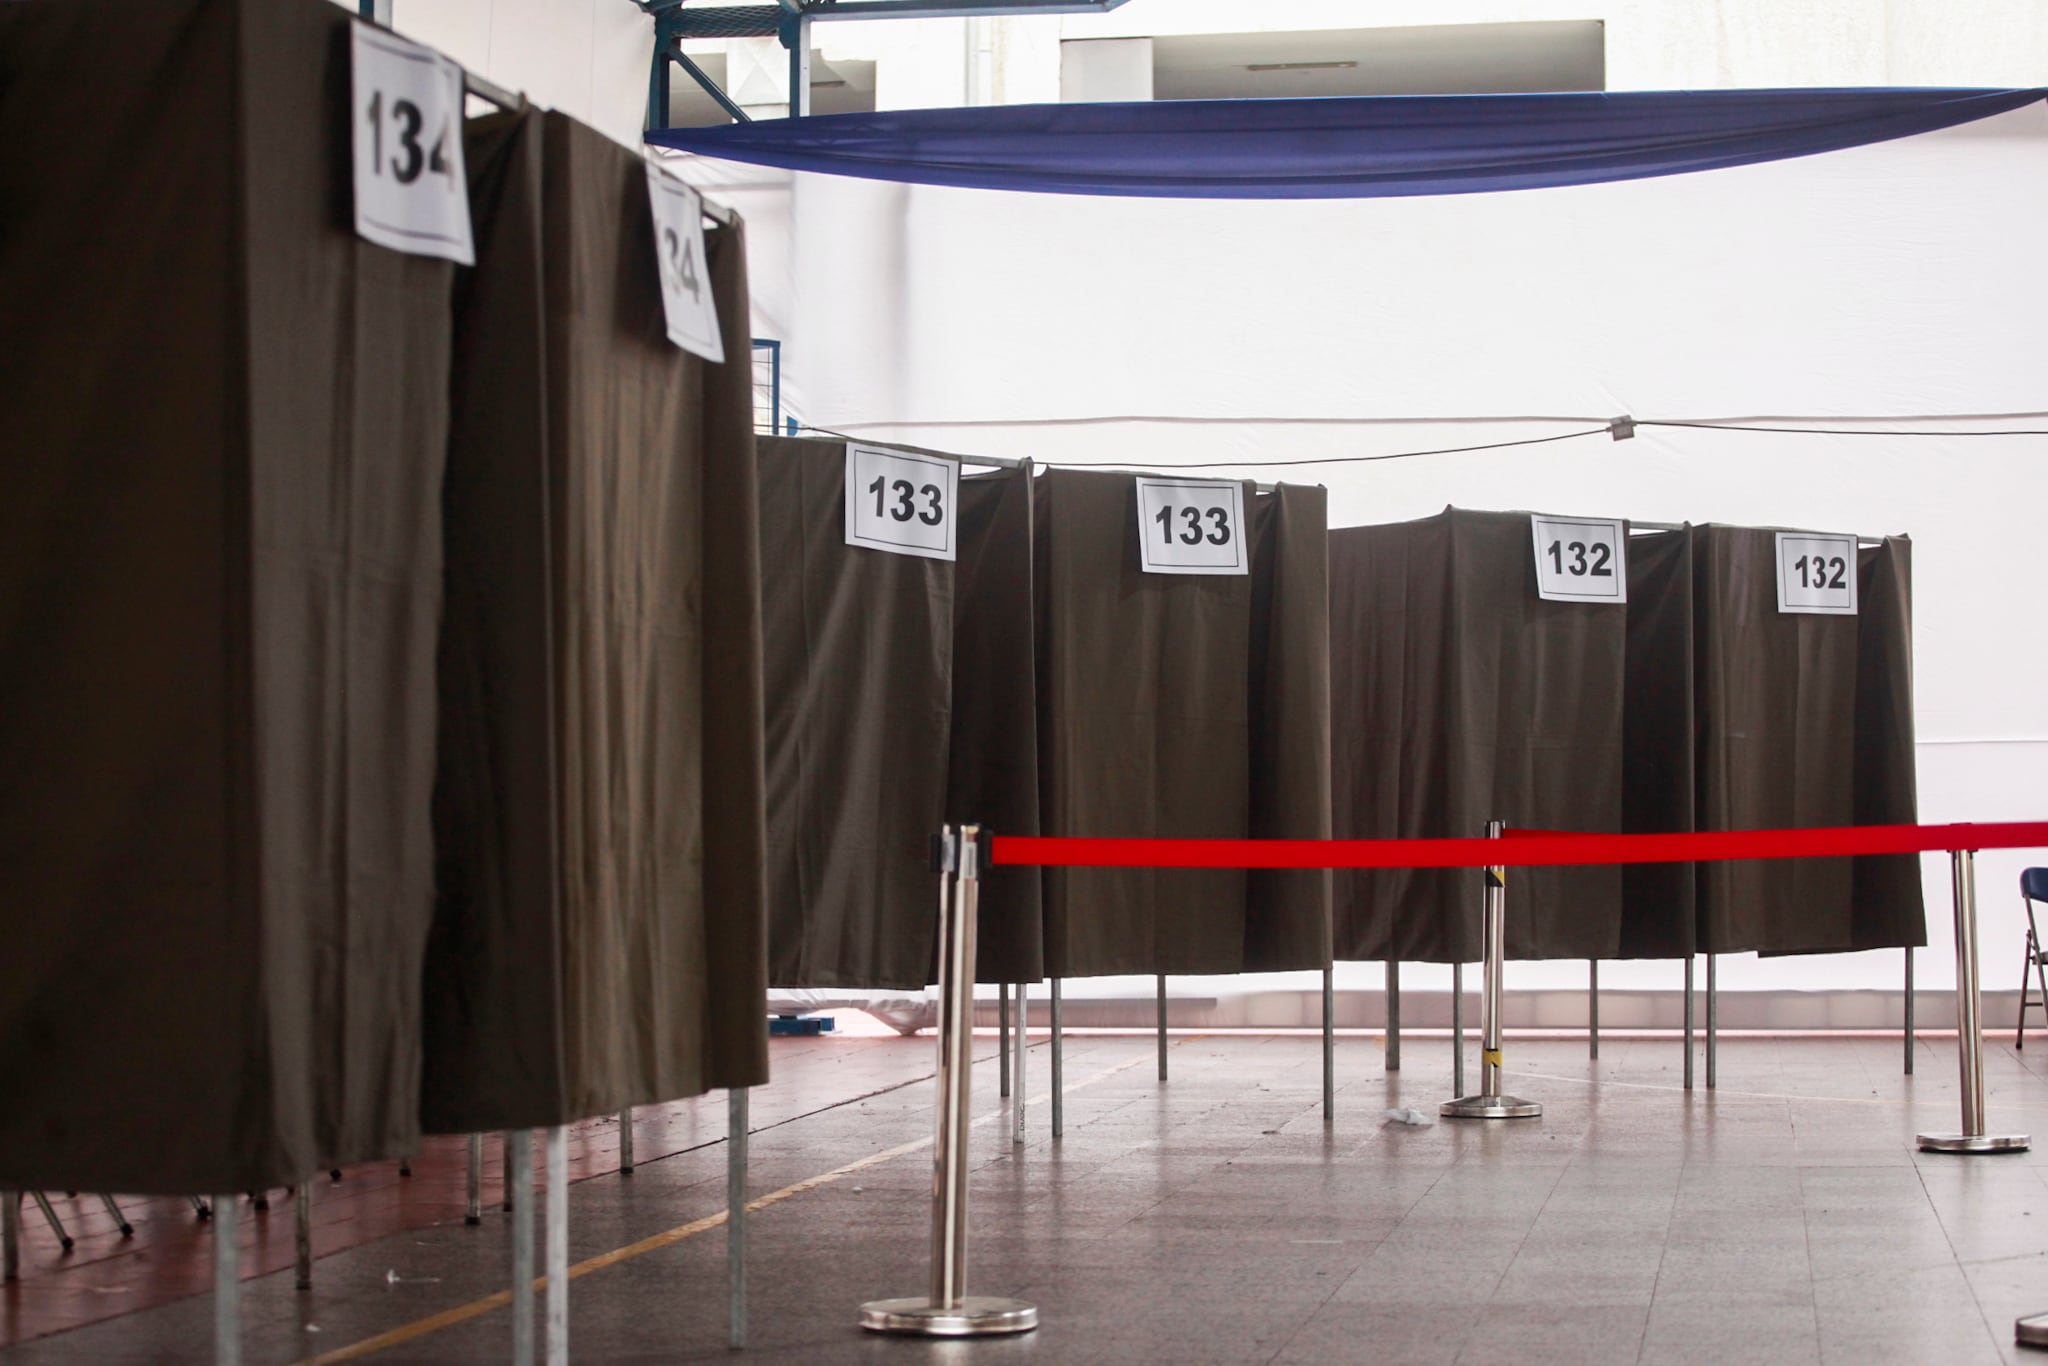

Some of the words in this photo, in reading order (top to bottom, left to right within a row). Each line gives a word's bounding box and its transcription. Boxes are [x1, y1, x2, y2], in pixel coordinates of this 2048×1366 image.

[367, 90, 453, 191] 134
[869, 475, 943, 526] 133
[1155, 505, 1231, 546] 133
[1548, 540, 1612, 577] 132
[1794, 555, 1847, 590] 132
